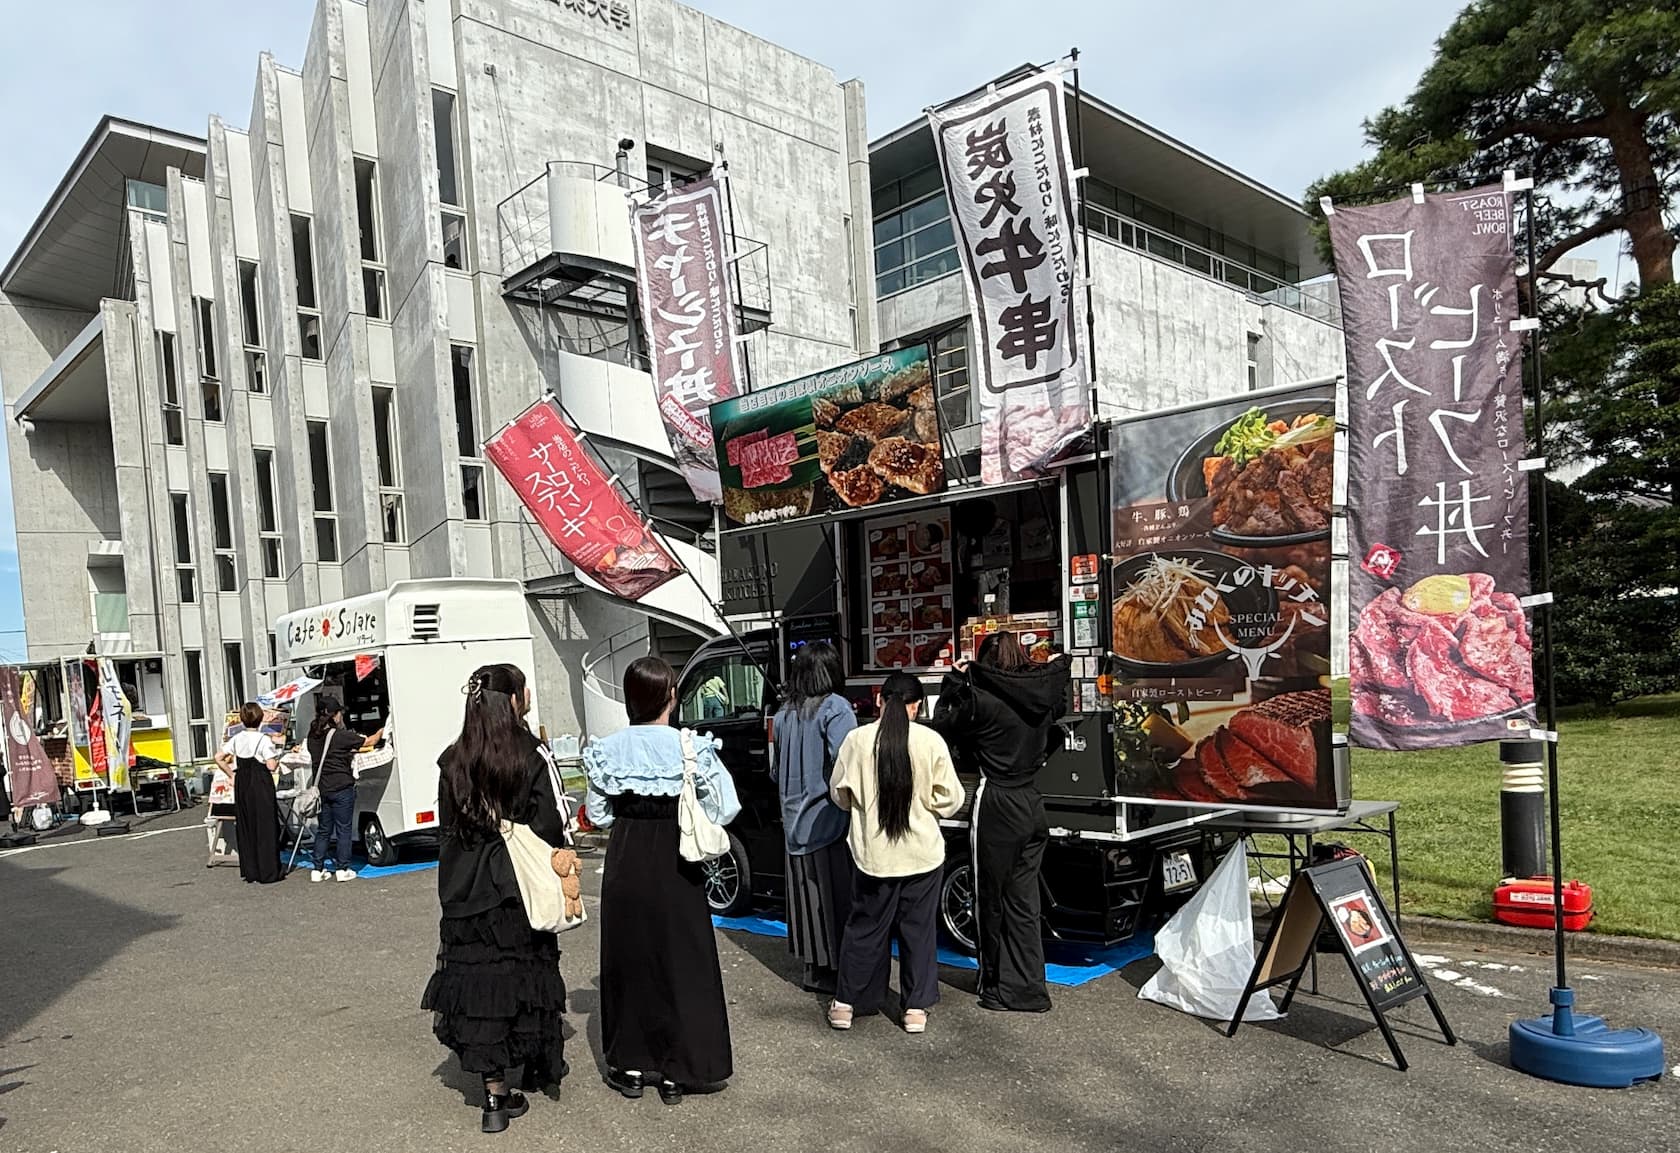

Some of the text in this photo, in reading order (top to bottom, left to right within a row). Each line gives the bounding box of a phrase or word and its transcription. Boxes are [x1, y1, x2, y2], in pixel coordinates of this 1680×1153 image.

[544, 0, 631, 31] 大学
[527, 441, 593, 518] サーロイン
[524, 471, 586, 538] ステーキ
[287, 607, 377, 648] Café Solare
[1229, 612, 1285, 625] SPECIAL
[1237, 626, 1276, 639] MENU
